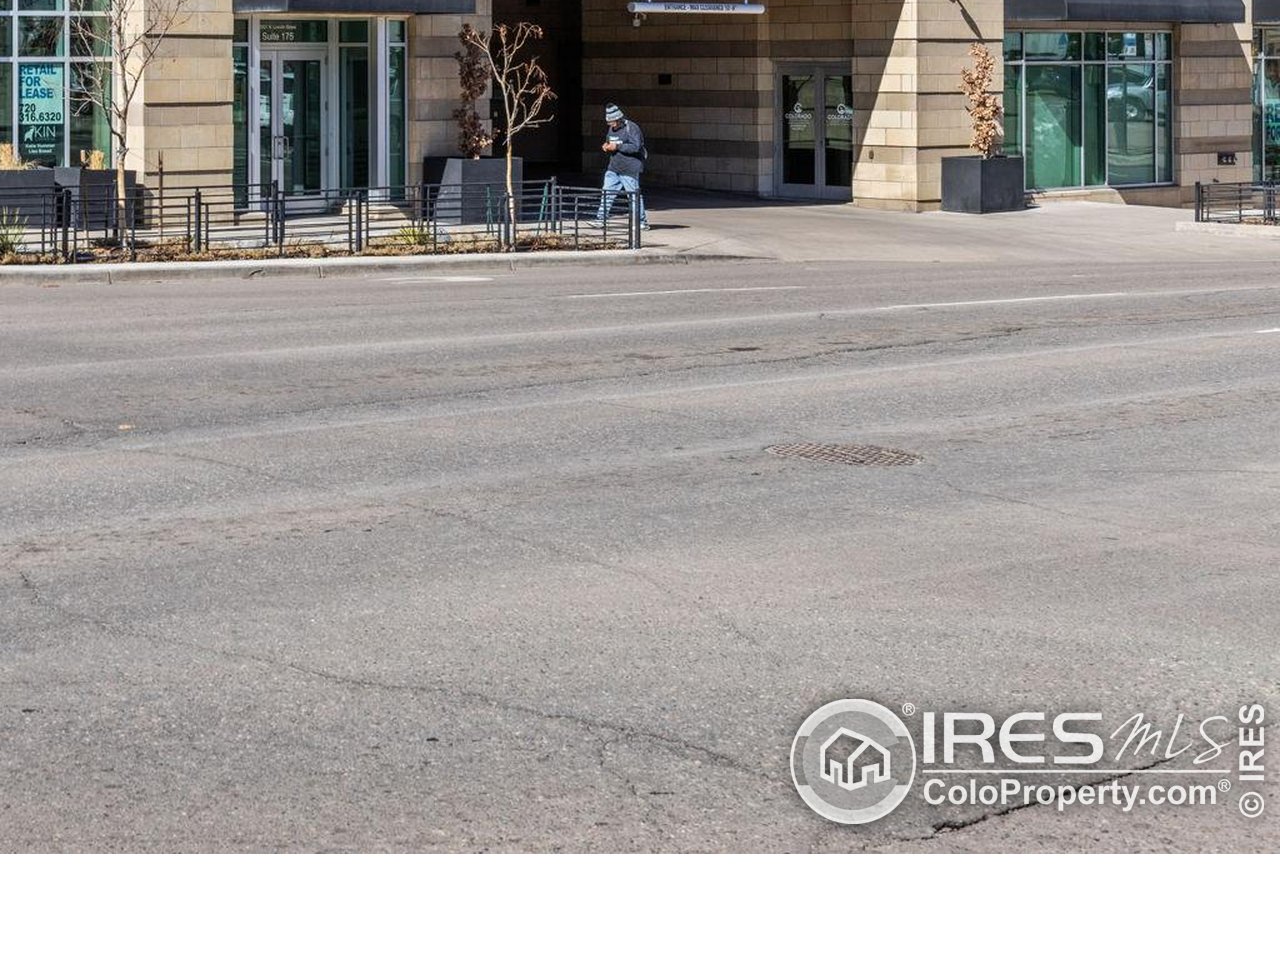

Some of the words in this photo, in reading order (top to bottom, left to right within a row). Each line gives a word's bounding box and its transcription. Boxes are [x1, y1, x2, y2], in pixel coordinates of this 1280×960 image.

[19, 64, 57, 75] RETAIL
[19, 76, 41, 87] FOR
[20, 88, 54, 99] LEASE
[19, 103, 36, 113] 720
[19, 112, 61, 122] 316.6320
[34, 126, 56, 138] KIN
